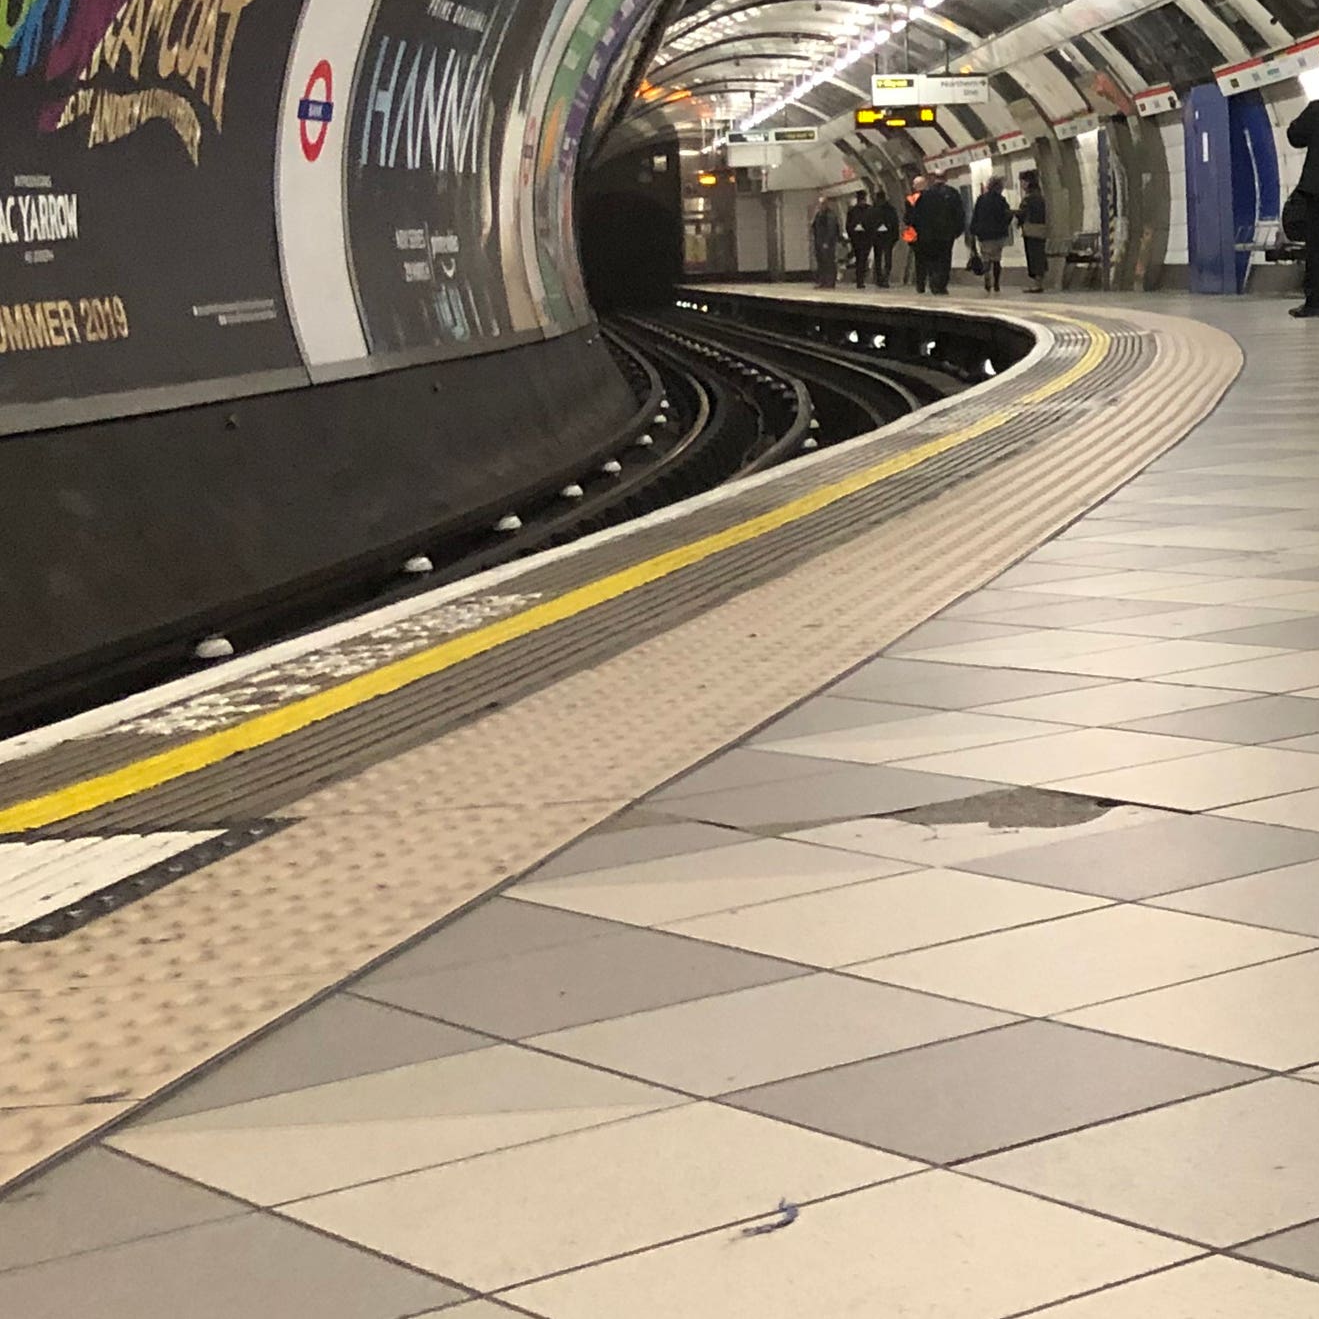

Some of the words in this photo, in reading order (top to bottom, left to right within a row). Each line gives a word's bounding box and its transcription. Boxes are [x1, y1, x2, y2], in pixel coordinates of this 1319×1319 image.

[359, 35, 487, 174] HANNA
[18, 193, 79, 241] YARROW
[79, 294, 129, 342] 2019
